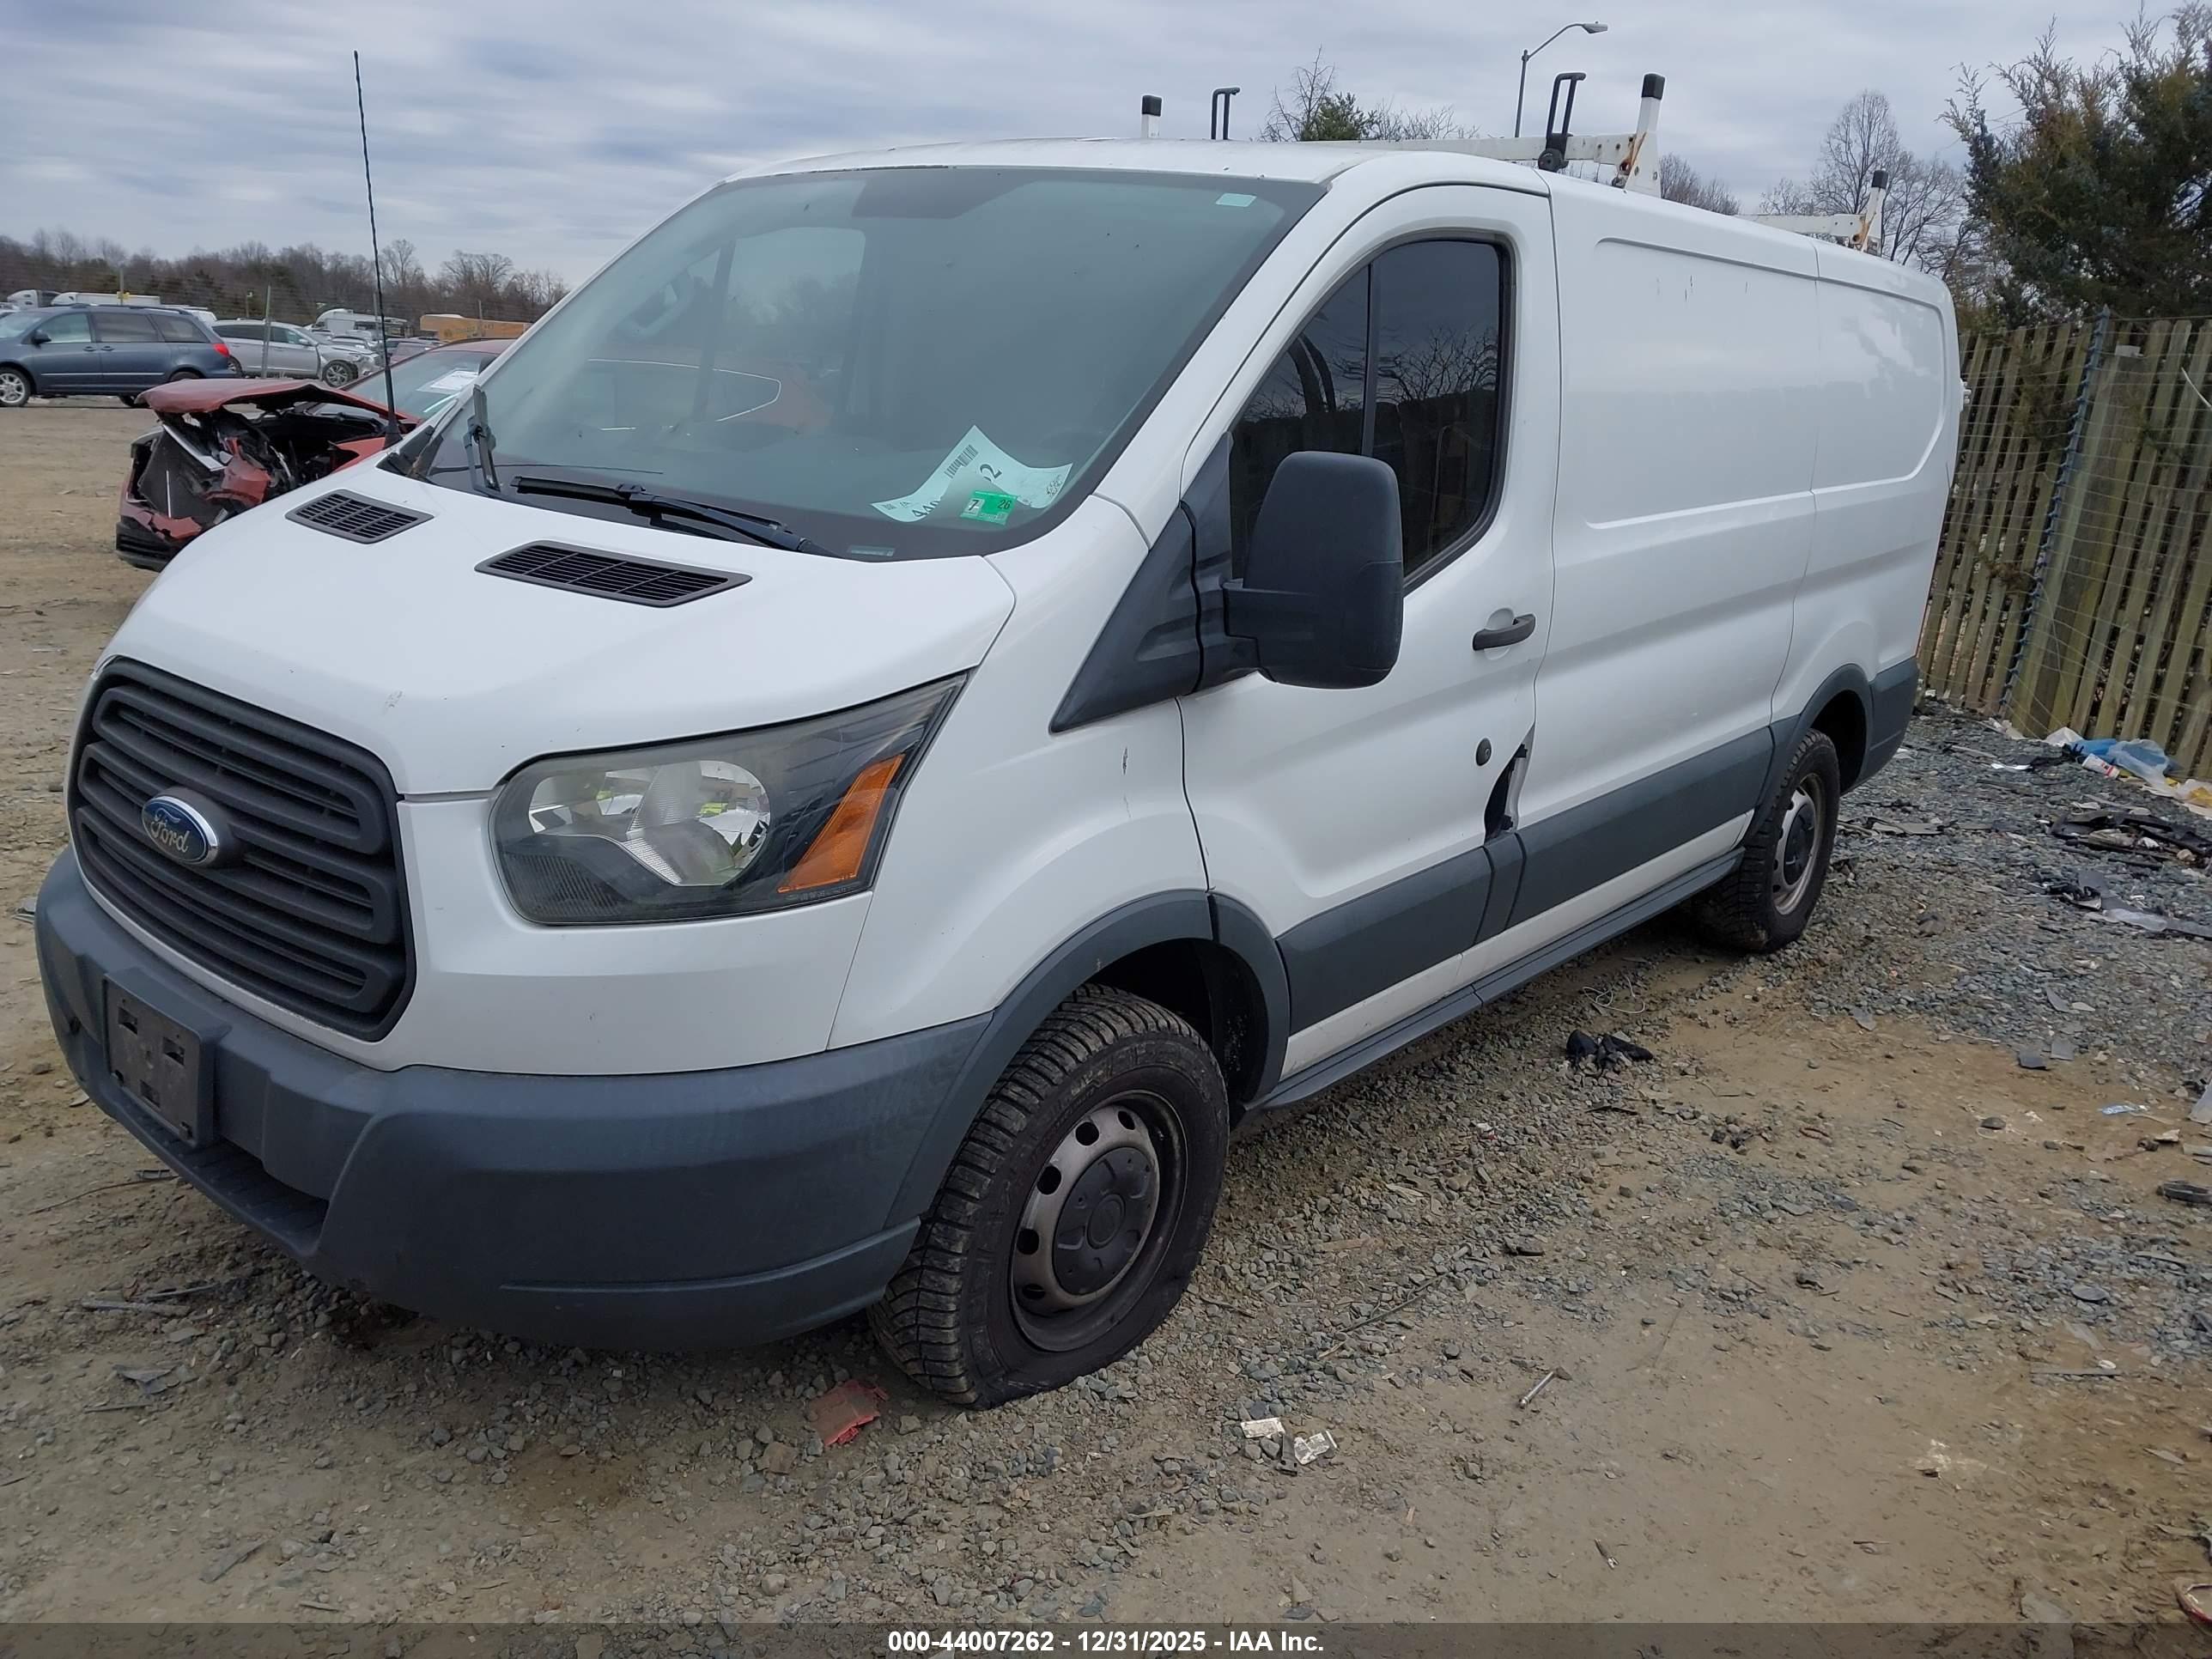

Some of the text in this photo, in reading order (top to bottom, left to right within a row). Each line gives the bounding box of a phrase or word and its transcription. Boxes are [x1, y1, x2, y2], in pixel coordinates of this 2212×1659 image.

[969, 500, 1012, 511] 7 26
[150, 807, 191, 853] Ford
